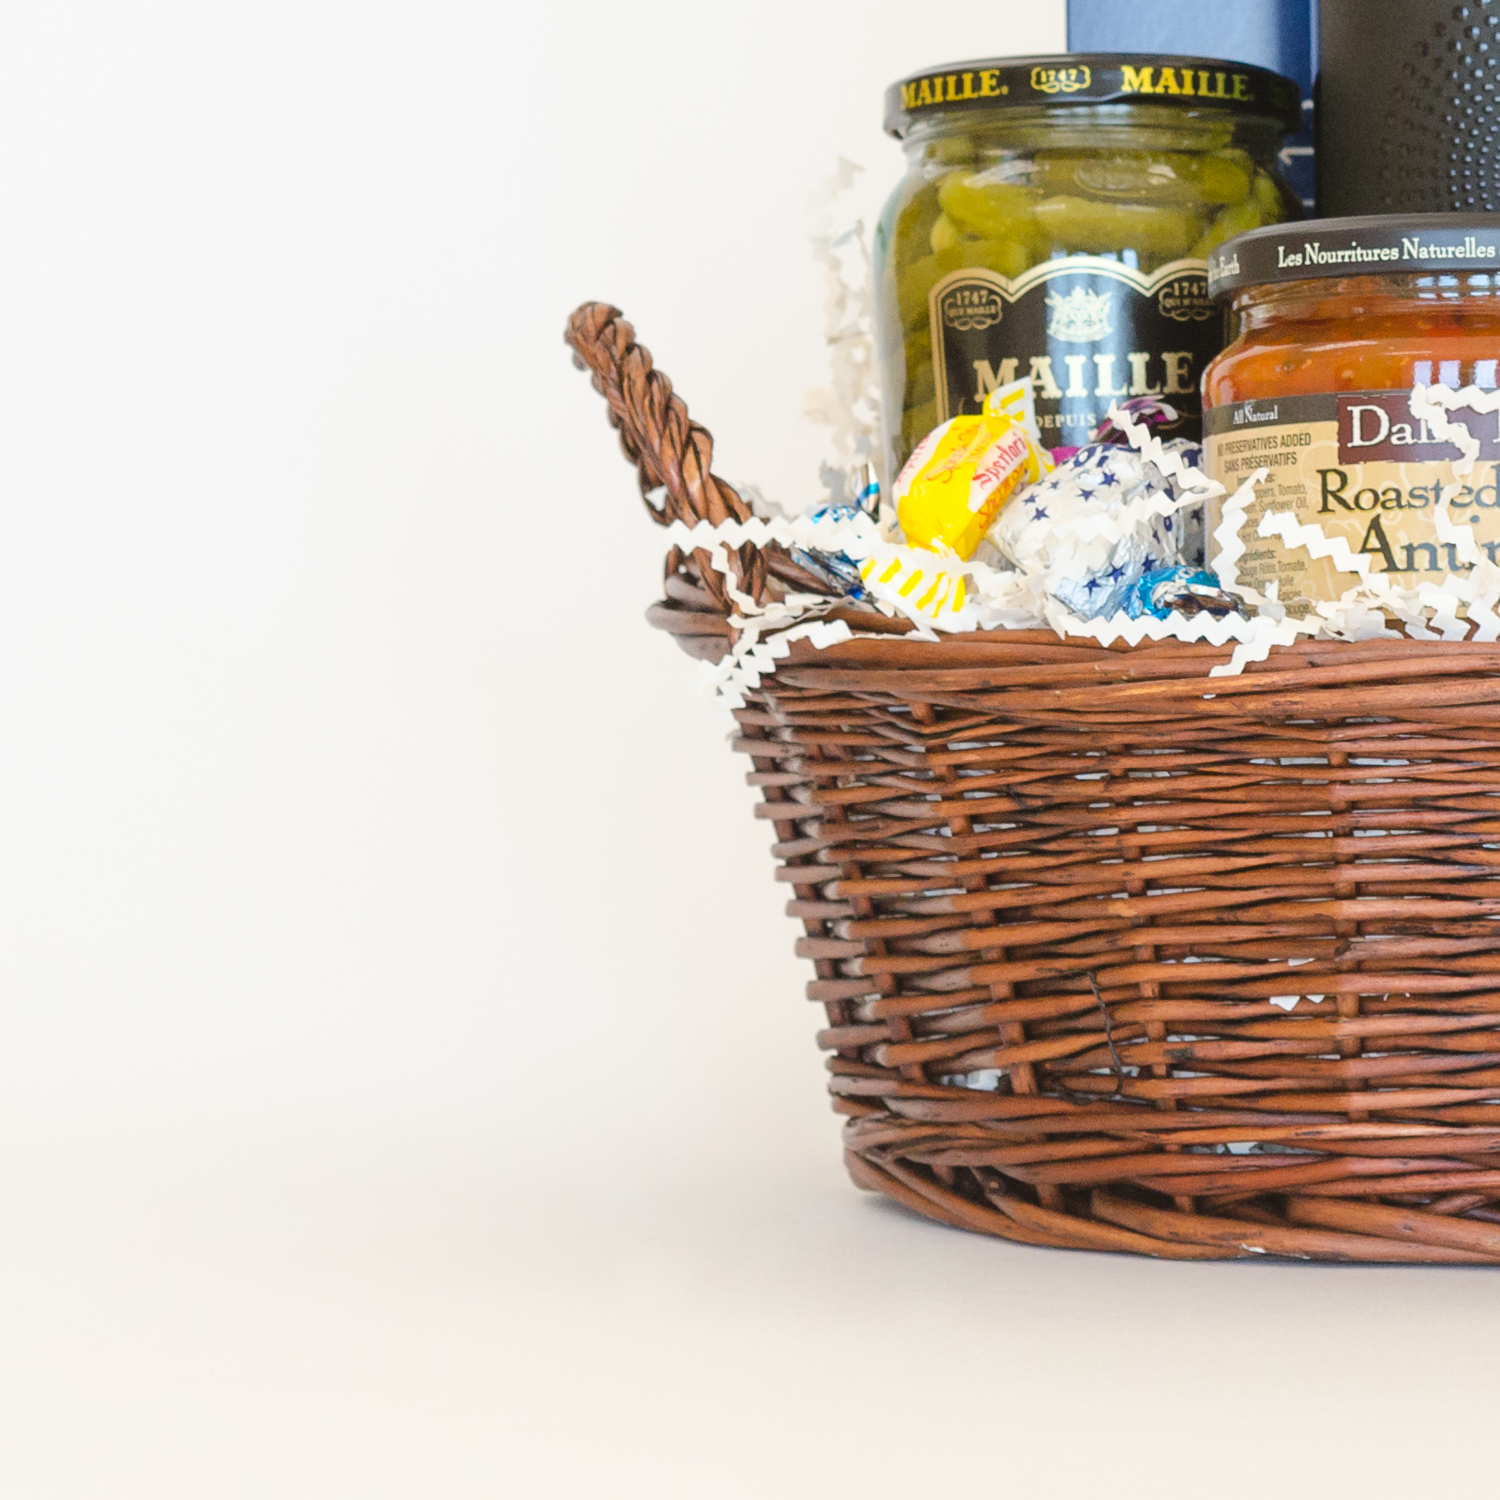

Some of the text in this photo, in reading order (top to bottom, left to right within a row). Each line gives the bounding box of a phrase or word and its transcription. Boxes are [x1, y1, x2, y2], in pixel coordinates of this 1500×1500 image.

[1040, 68, 1078, 83] 1747
[1278, 245, 1303, 268] Les
[1305, 241, 1400, 266] Nourritures
[1402, 236, 1496, 260] Naturelles
[973, 352, 1196, 403] MAILLE
[1245, 404, 1279, 424] Natural
[1225, 436, 1278, 456] PRESERVATIVES
[1280, 432, 1312, 449] ADDED
[1224, 451, 1298, 474] SANS PRÉSERVATIFS
